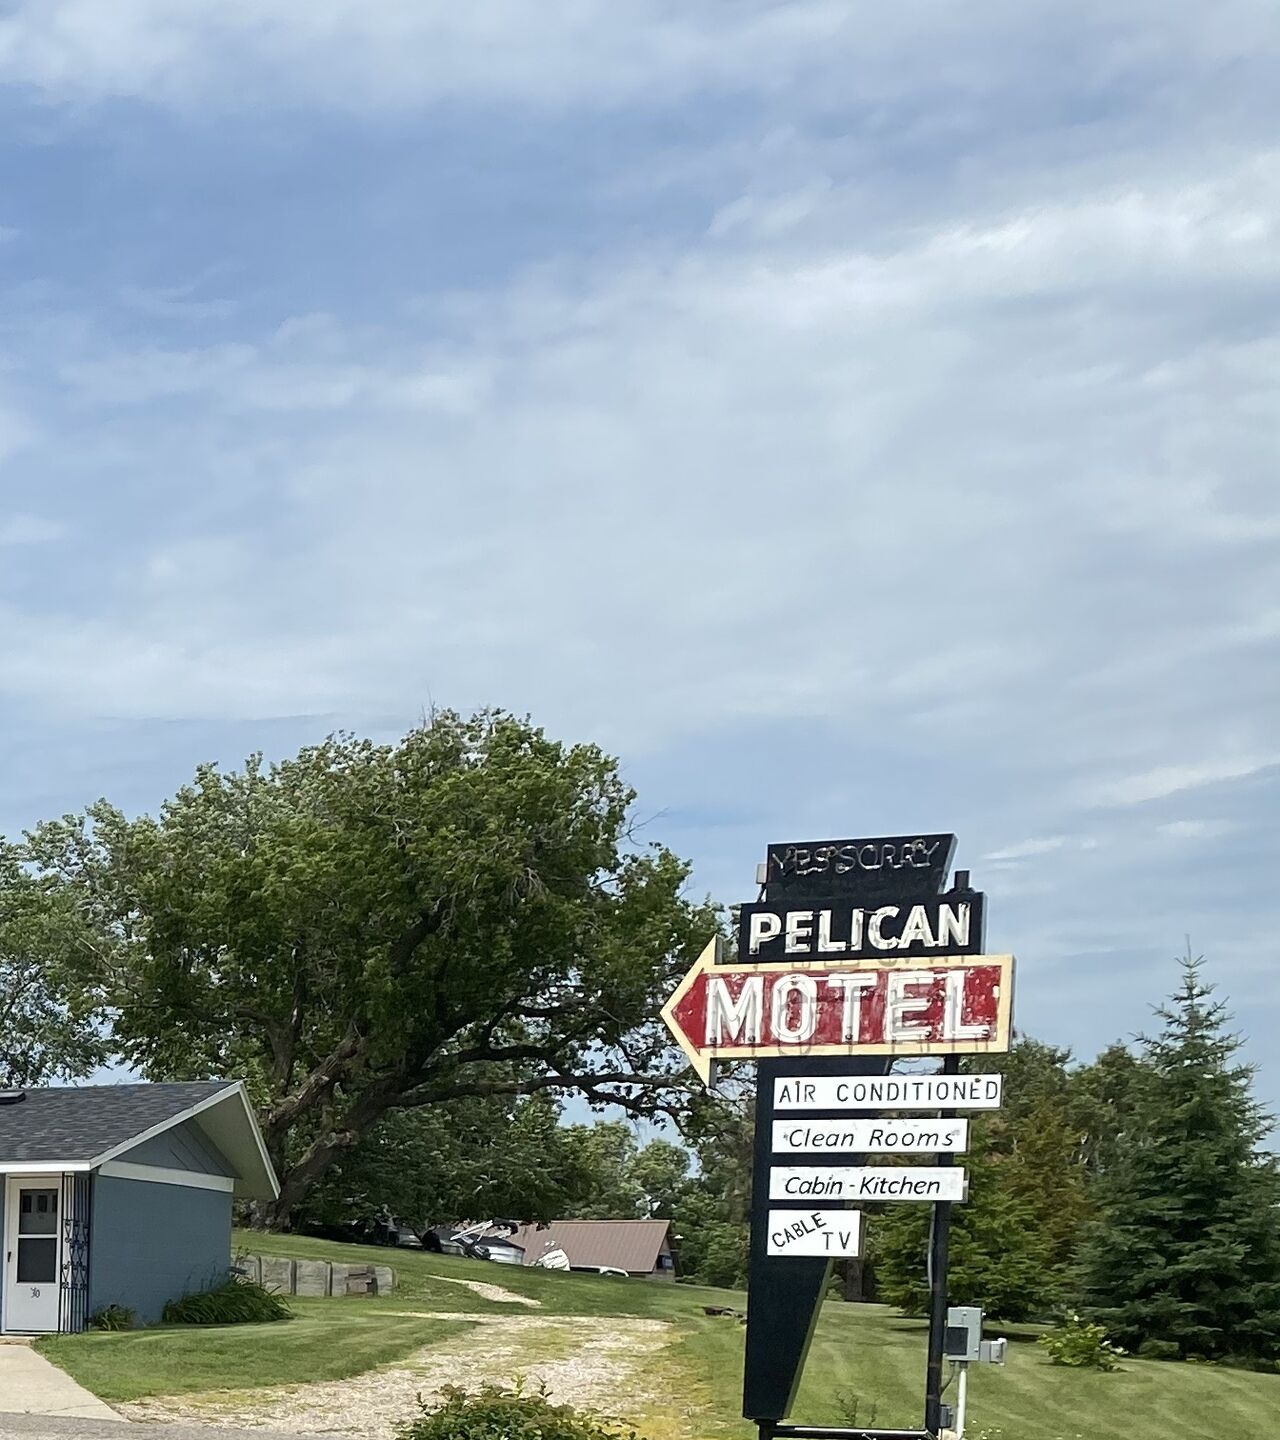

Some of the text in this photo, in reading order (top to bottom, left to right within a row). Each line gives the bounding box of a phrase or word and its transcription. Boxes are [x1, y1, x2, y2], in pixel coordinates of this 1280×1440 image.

[749, 902, 971, 956] PELICAN
[704, 969, 991, 1045] MOTEL
[778, 1080, 999, 1103] AIR CONDITIONED
[789, 1128, 955, 1148] Clean Rooms
[771, 1212, 828, 1248] CABLE
